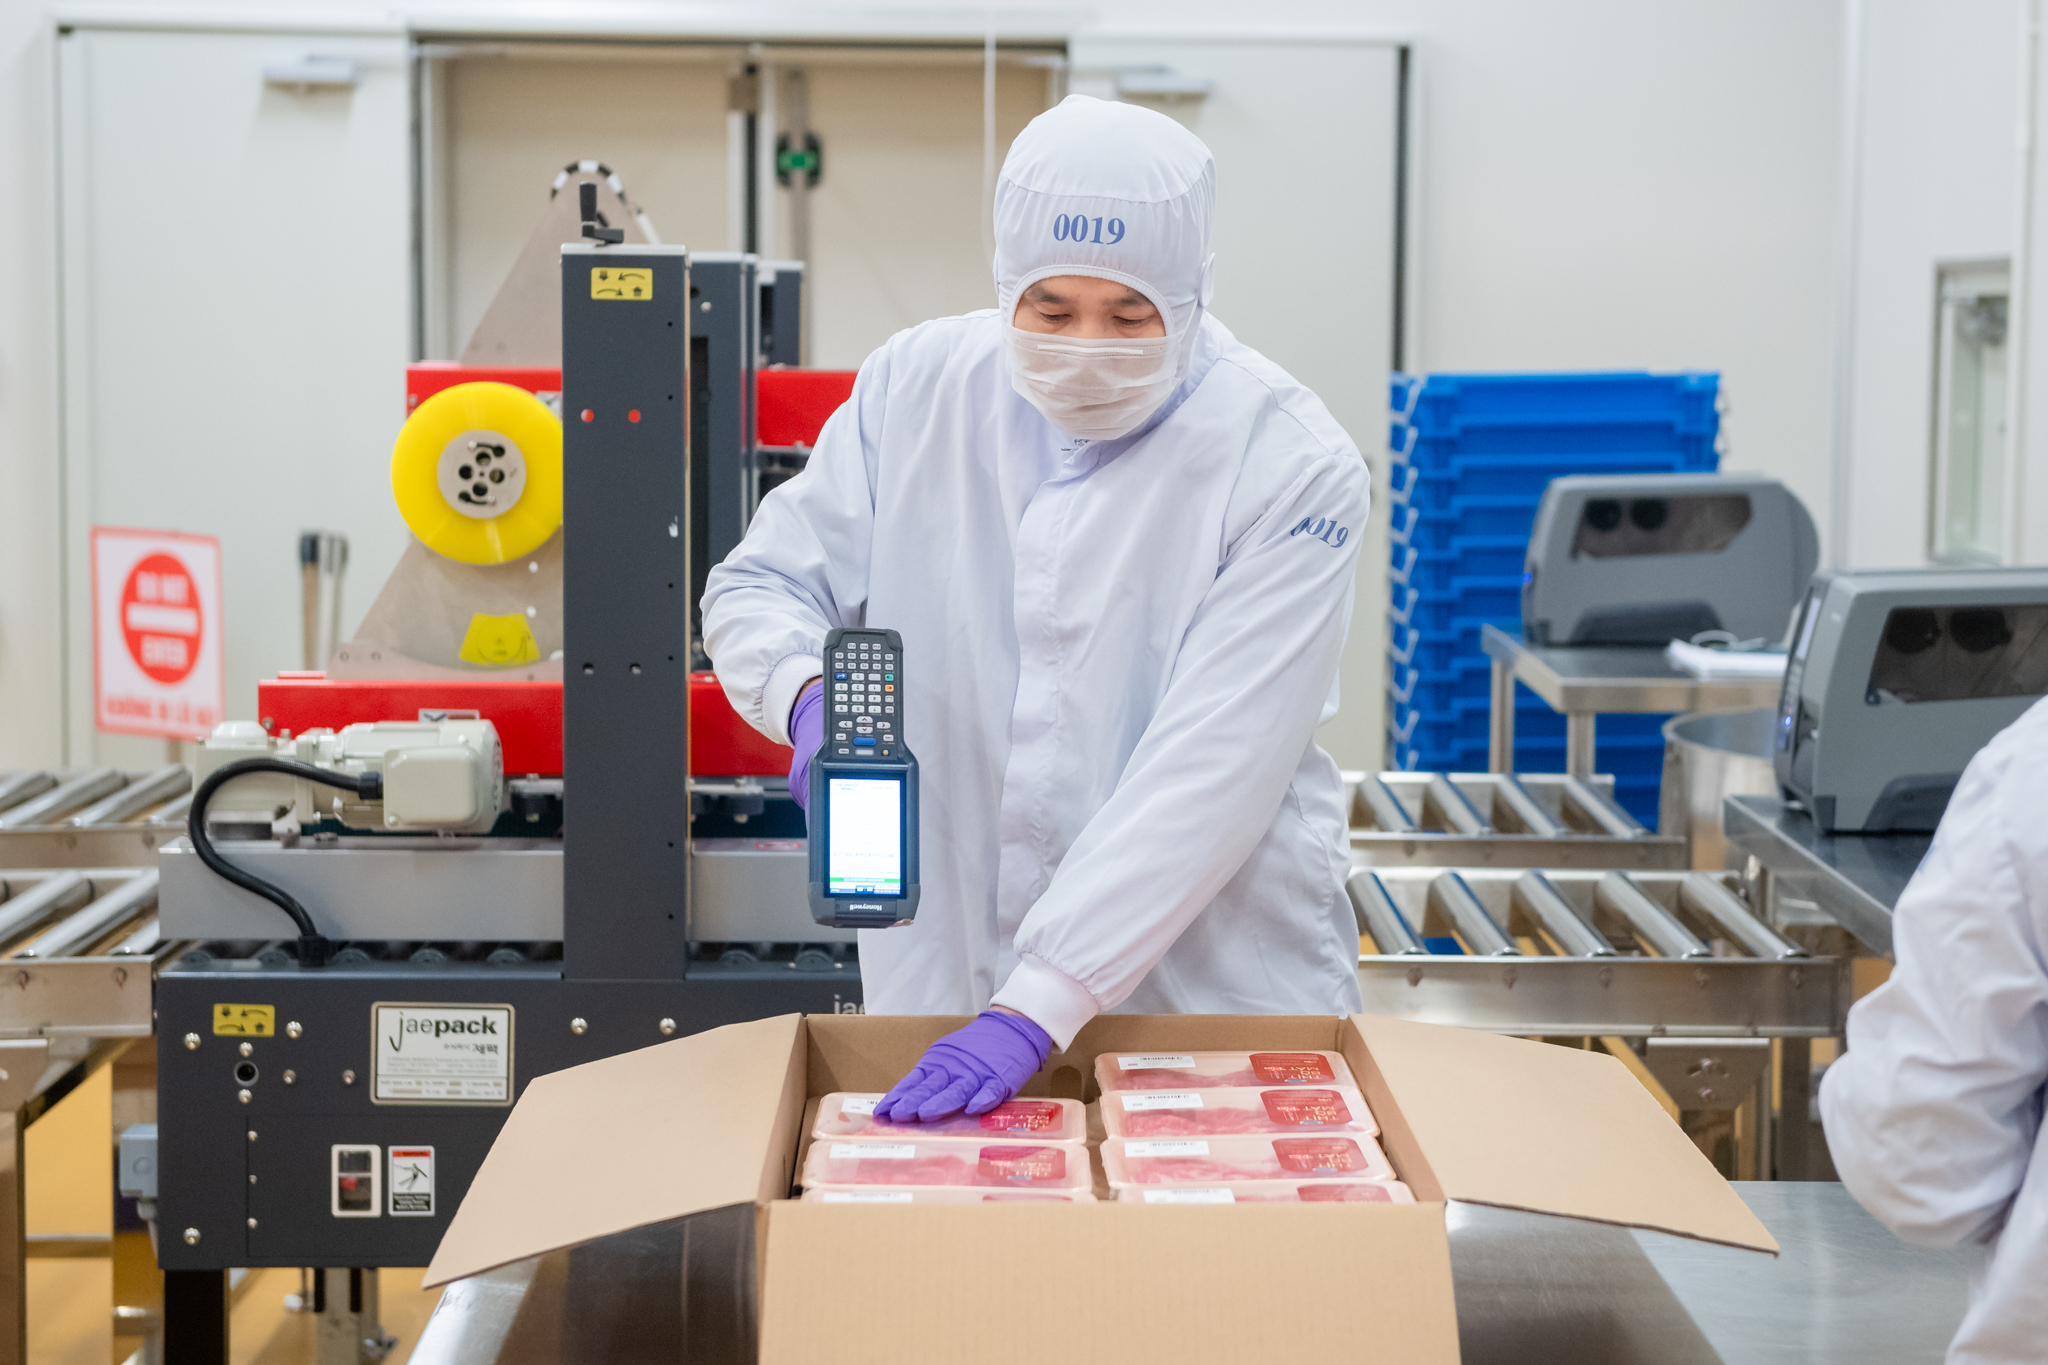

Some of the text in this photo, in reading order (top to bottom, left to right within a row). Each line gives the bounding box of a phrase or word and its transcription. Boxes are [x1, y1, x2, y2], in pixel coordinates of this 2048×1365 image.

[1053, 213, 1125, 245] 0019
[1290, 517, 1349, 548] 0019
[849, 903, 882, 911] Honeywell
[388, 1011, 498, 1052] jaepack
